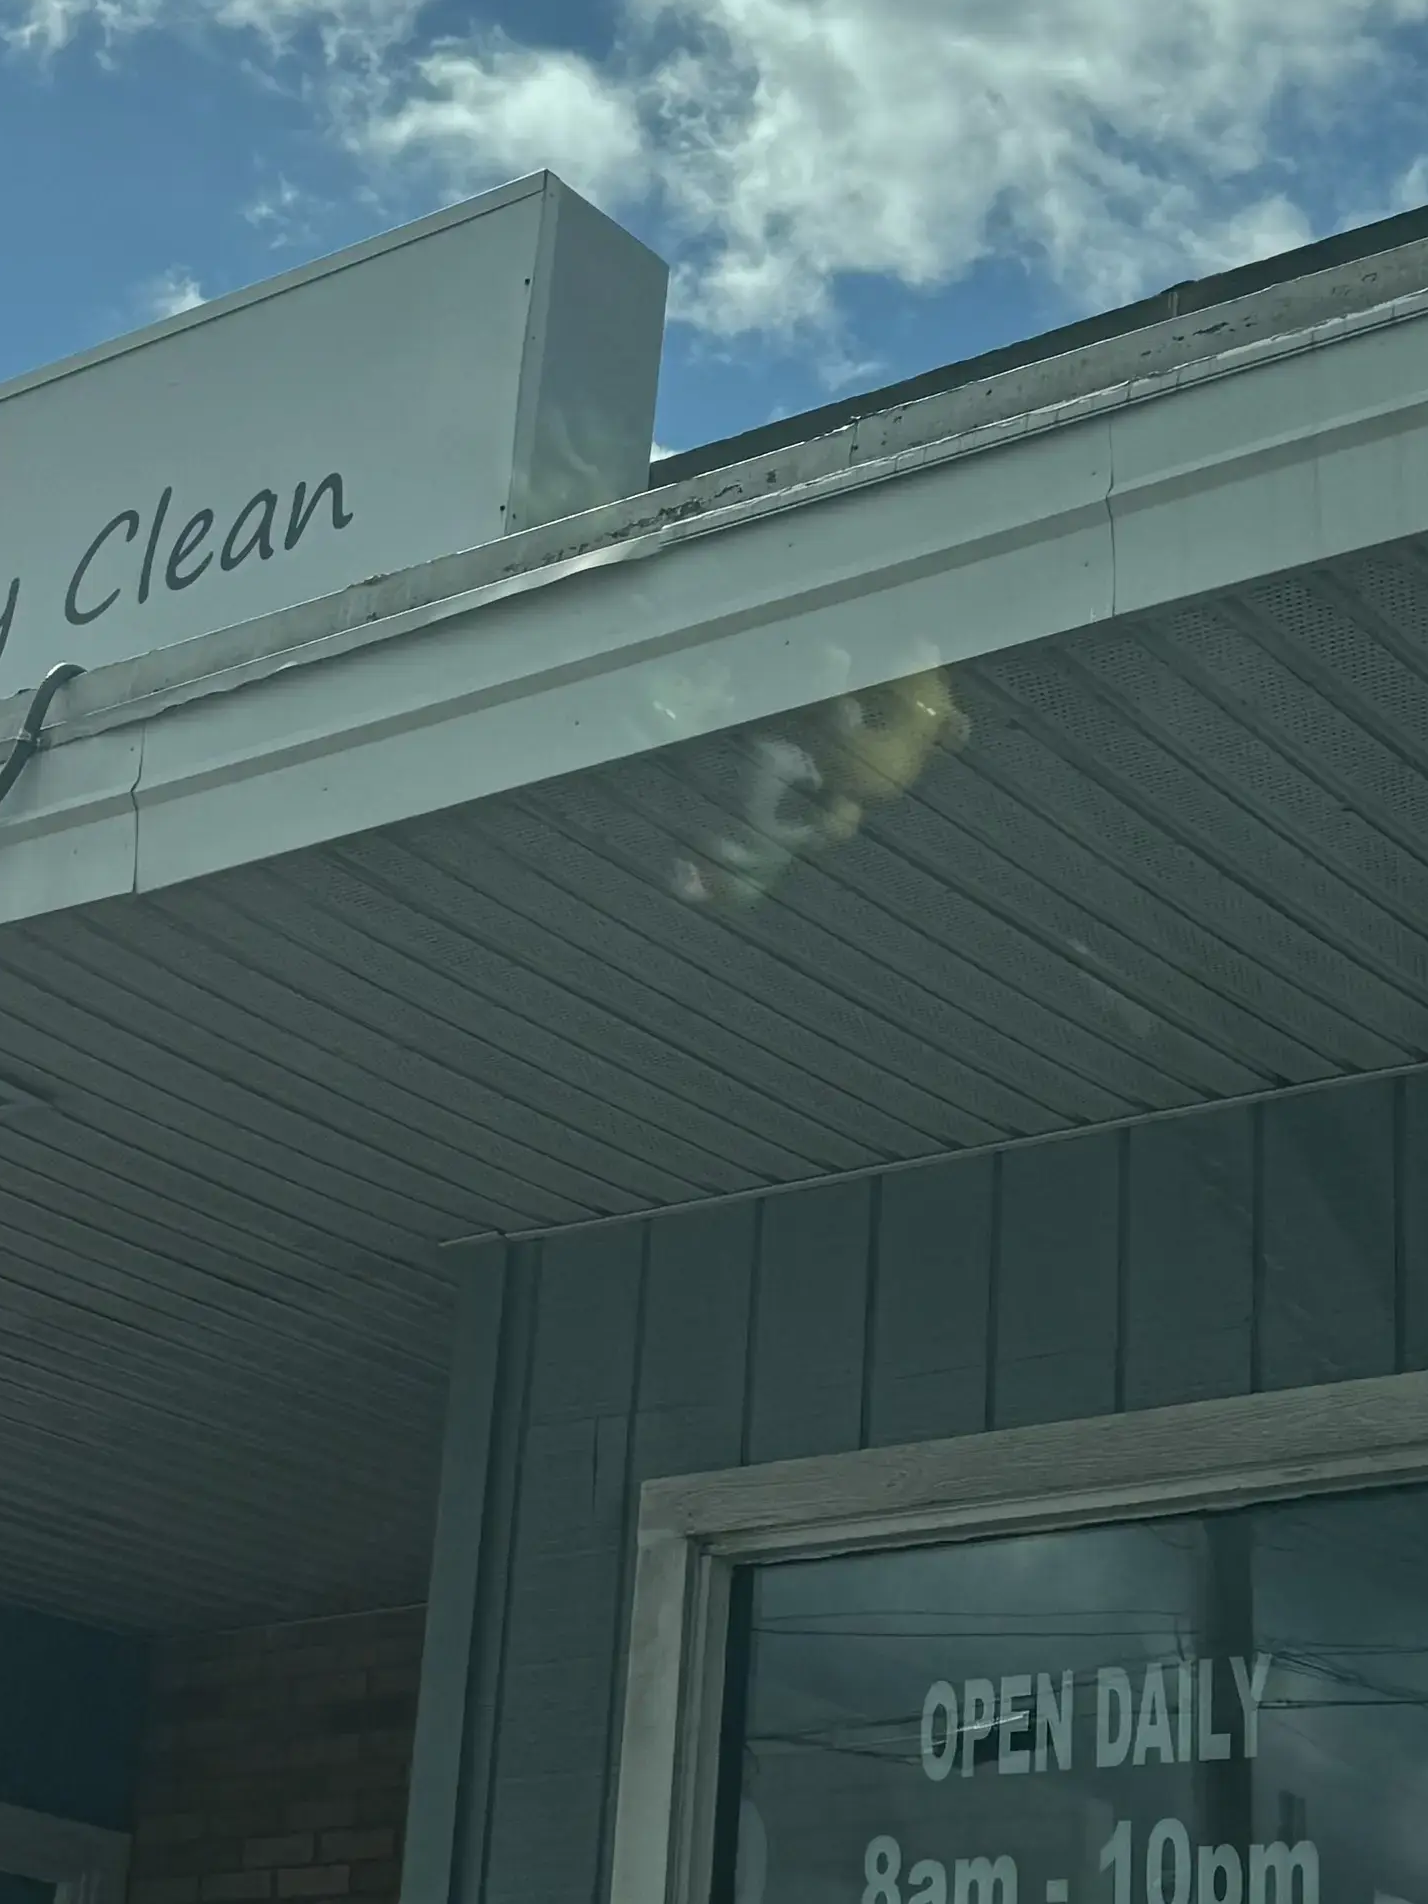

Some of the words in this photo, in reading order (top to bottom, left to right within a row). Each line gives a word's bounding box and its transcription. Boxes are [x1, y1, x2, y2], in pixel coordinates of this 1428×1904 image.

[63, 471, 353, 629] Clean
[921, 1669, 1074, 1781] OPEN
[1095, 1652, 1272, 1768] DAILY
